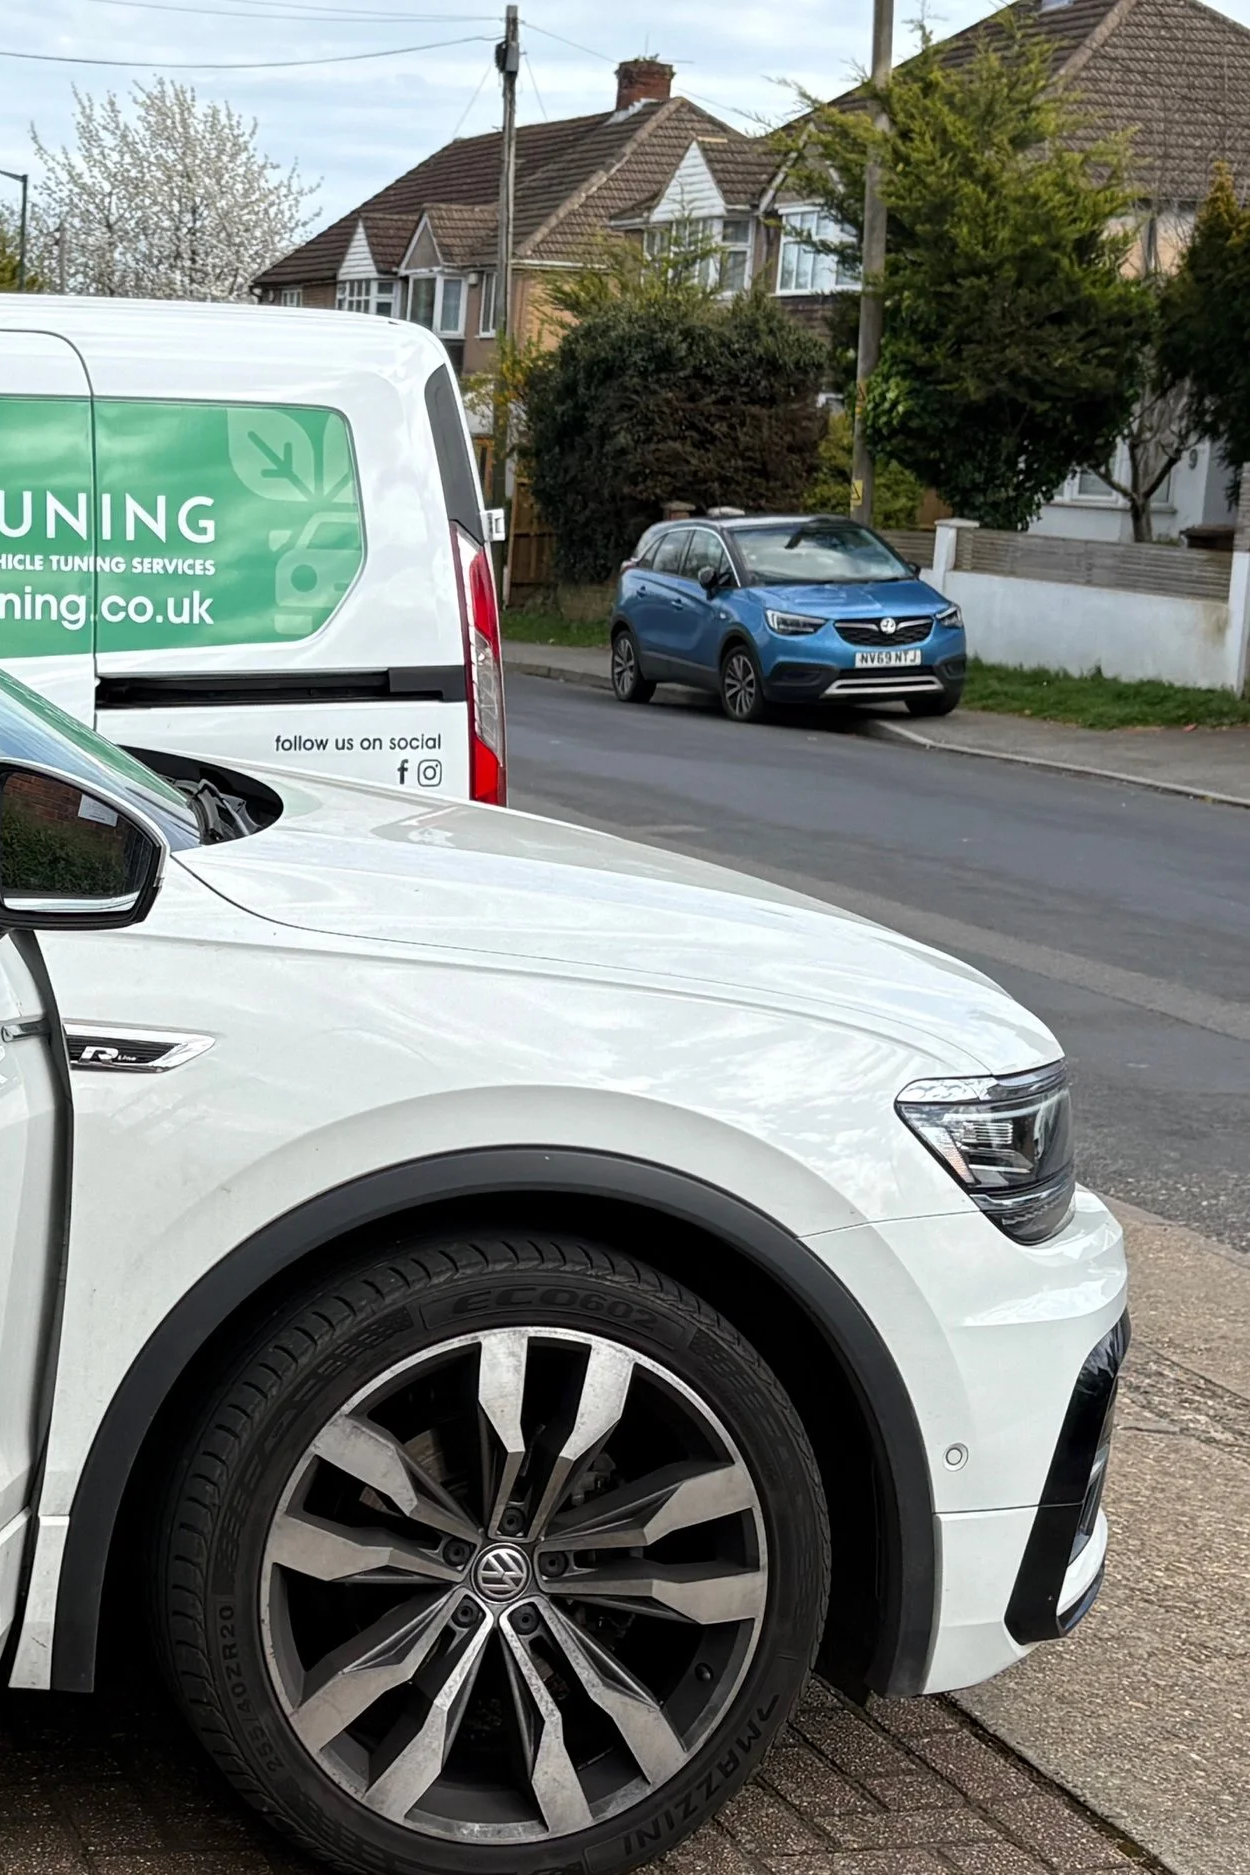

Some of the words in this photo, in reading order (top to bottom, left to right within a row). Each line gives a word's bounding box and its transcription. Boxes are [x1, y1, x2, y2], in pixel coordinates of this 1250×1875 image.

[49, 555, 127, 574] TUNING
[131, 557, 216, 576] SERVICES
[860, 652, 892, 665] NV69
[895, 649, 917, 663] NTJ
[275, 735, 329, 751] follow
[335, 738, 354, 751] us
[359, 737, 383, 751] on
[389, 733, 442, 750] social
[79, 1046, 119, 1064] R
[452, 1286, 659, 1332] ECO602
[218, 1603, 286, 1774] 255/40ZR20
[622, 1719, 764, 1856] MAZZINI
